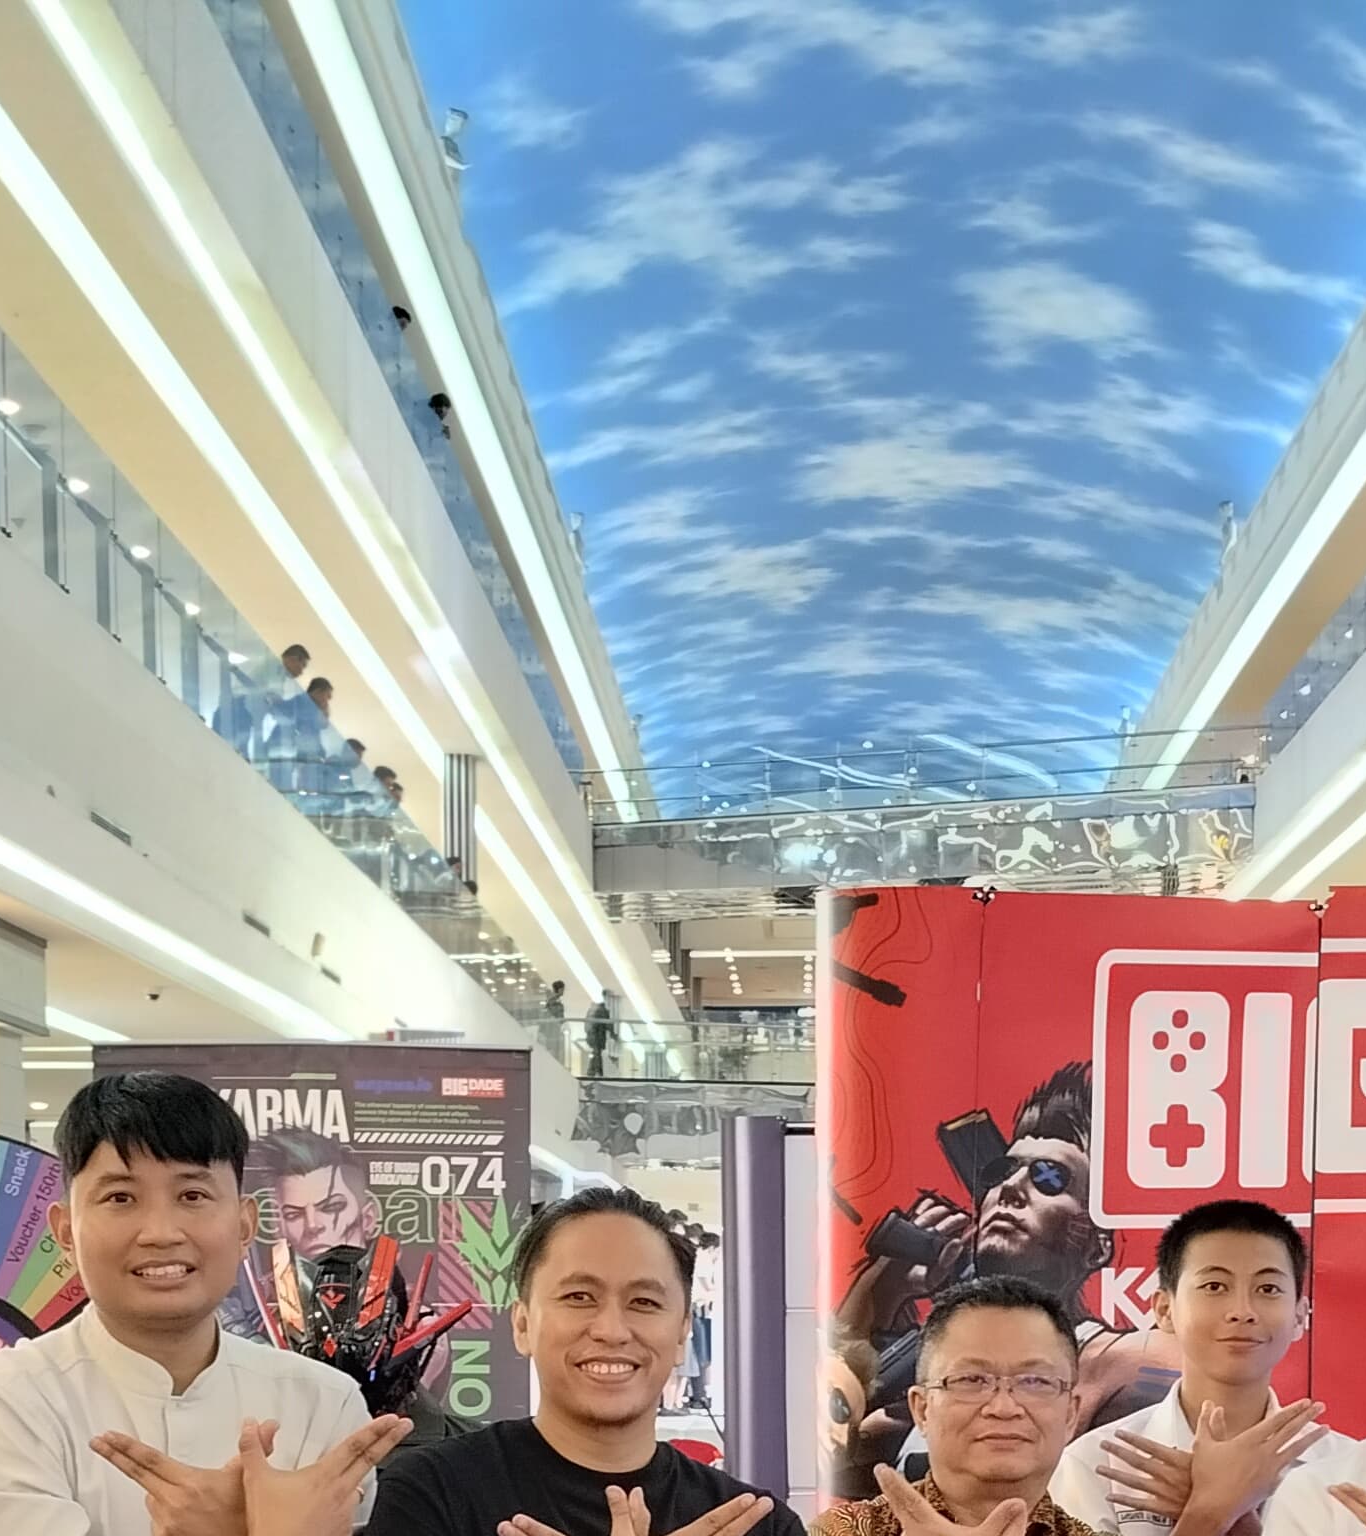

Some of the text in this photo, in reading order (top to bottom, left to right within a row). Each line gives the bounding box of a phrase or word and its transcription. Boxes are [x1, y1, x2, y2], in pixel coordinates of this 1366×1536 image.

[441, 1077, 468, 1097] BIG
[468, 1078, 504, 1092] DADE
[215, 1088, 351, 1144] ARMA
[4, 1149, 32, 1197] Snack
[422, 1155, 507, 1196] 074
[6, 1205, 43, 1264] Voucher
[35, 1163, 62, 1203] 150rb
